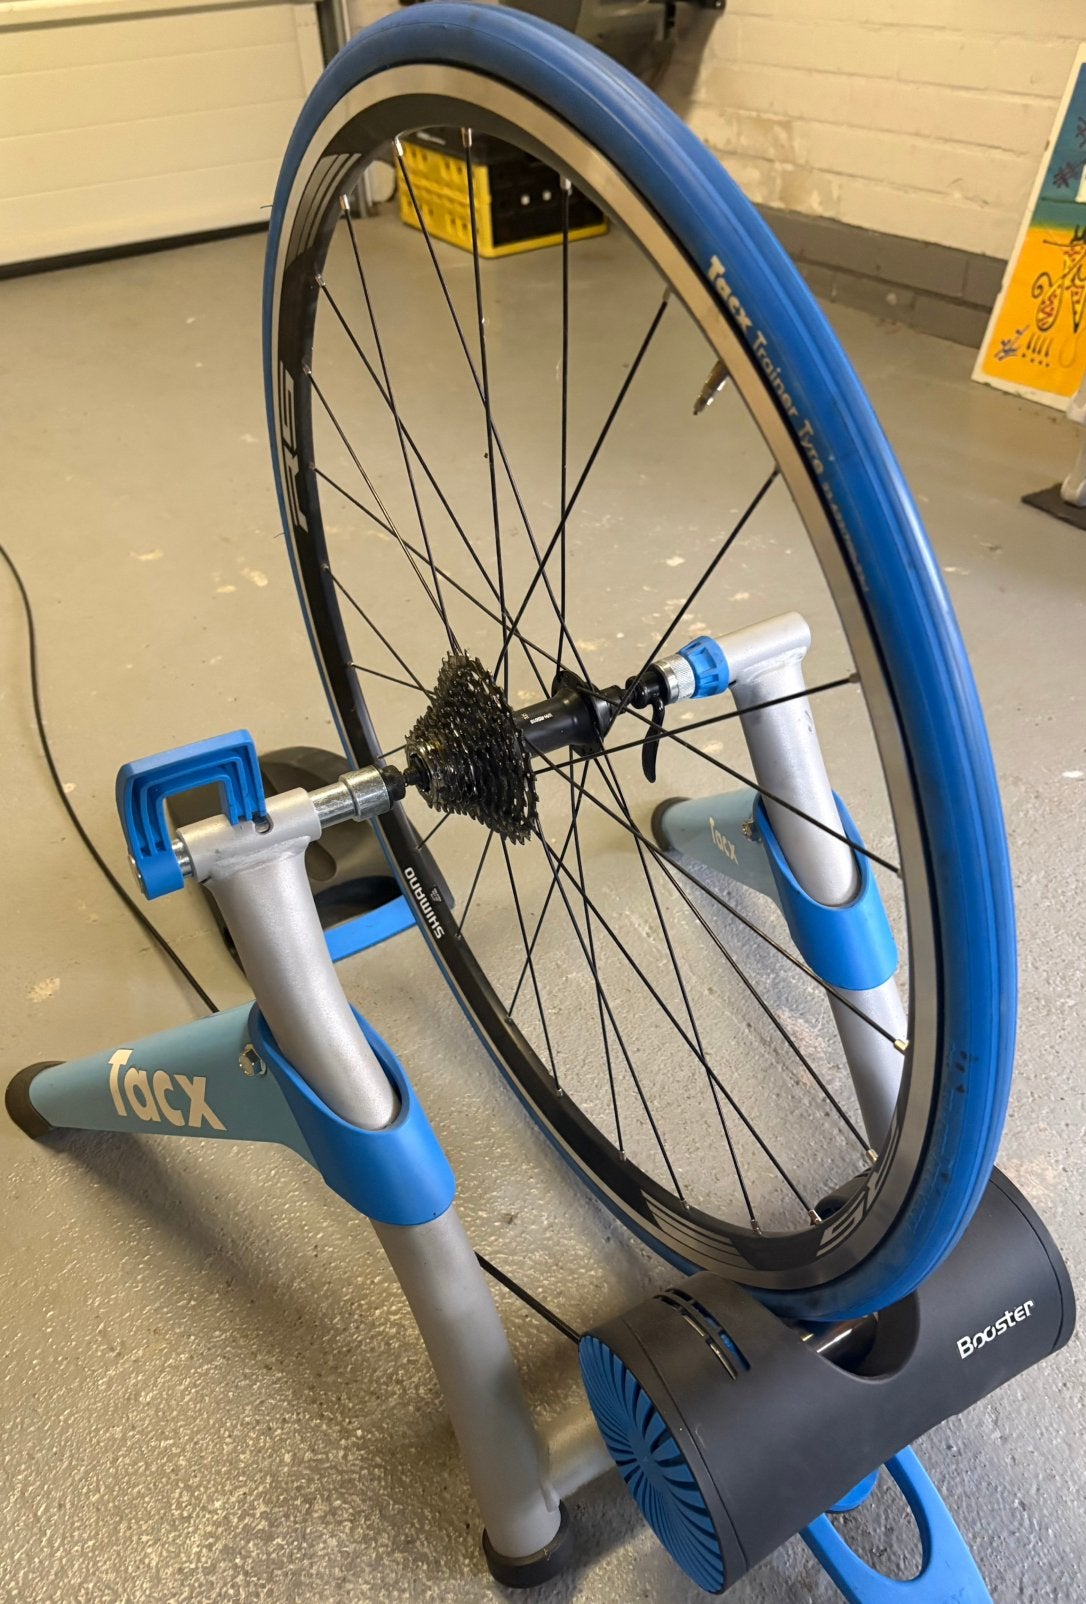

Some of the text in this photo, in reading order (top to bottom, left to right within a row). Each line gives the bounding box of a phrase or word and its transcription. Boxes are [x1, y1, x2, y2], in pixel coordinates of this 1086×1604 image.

[708, 255, 824, 473] Tacx Trainer Tyre
[709, 816, 739, 865] Tacx
[404, 867, 445, 939] SHIMANO
[108, 1049, 227, 1131] Tacx
[956, 1300, 1034, 1360] Booster
